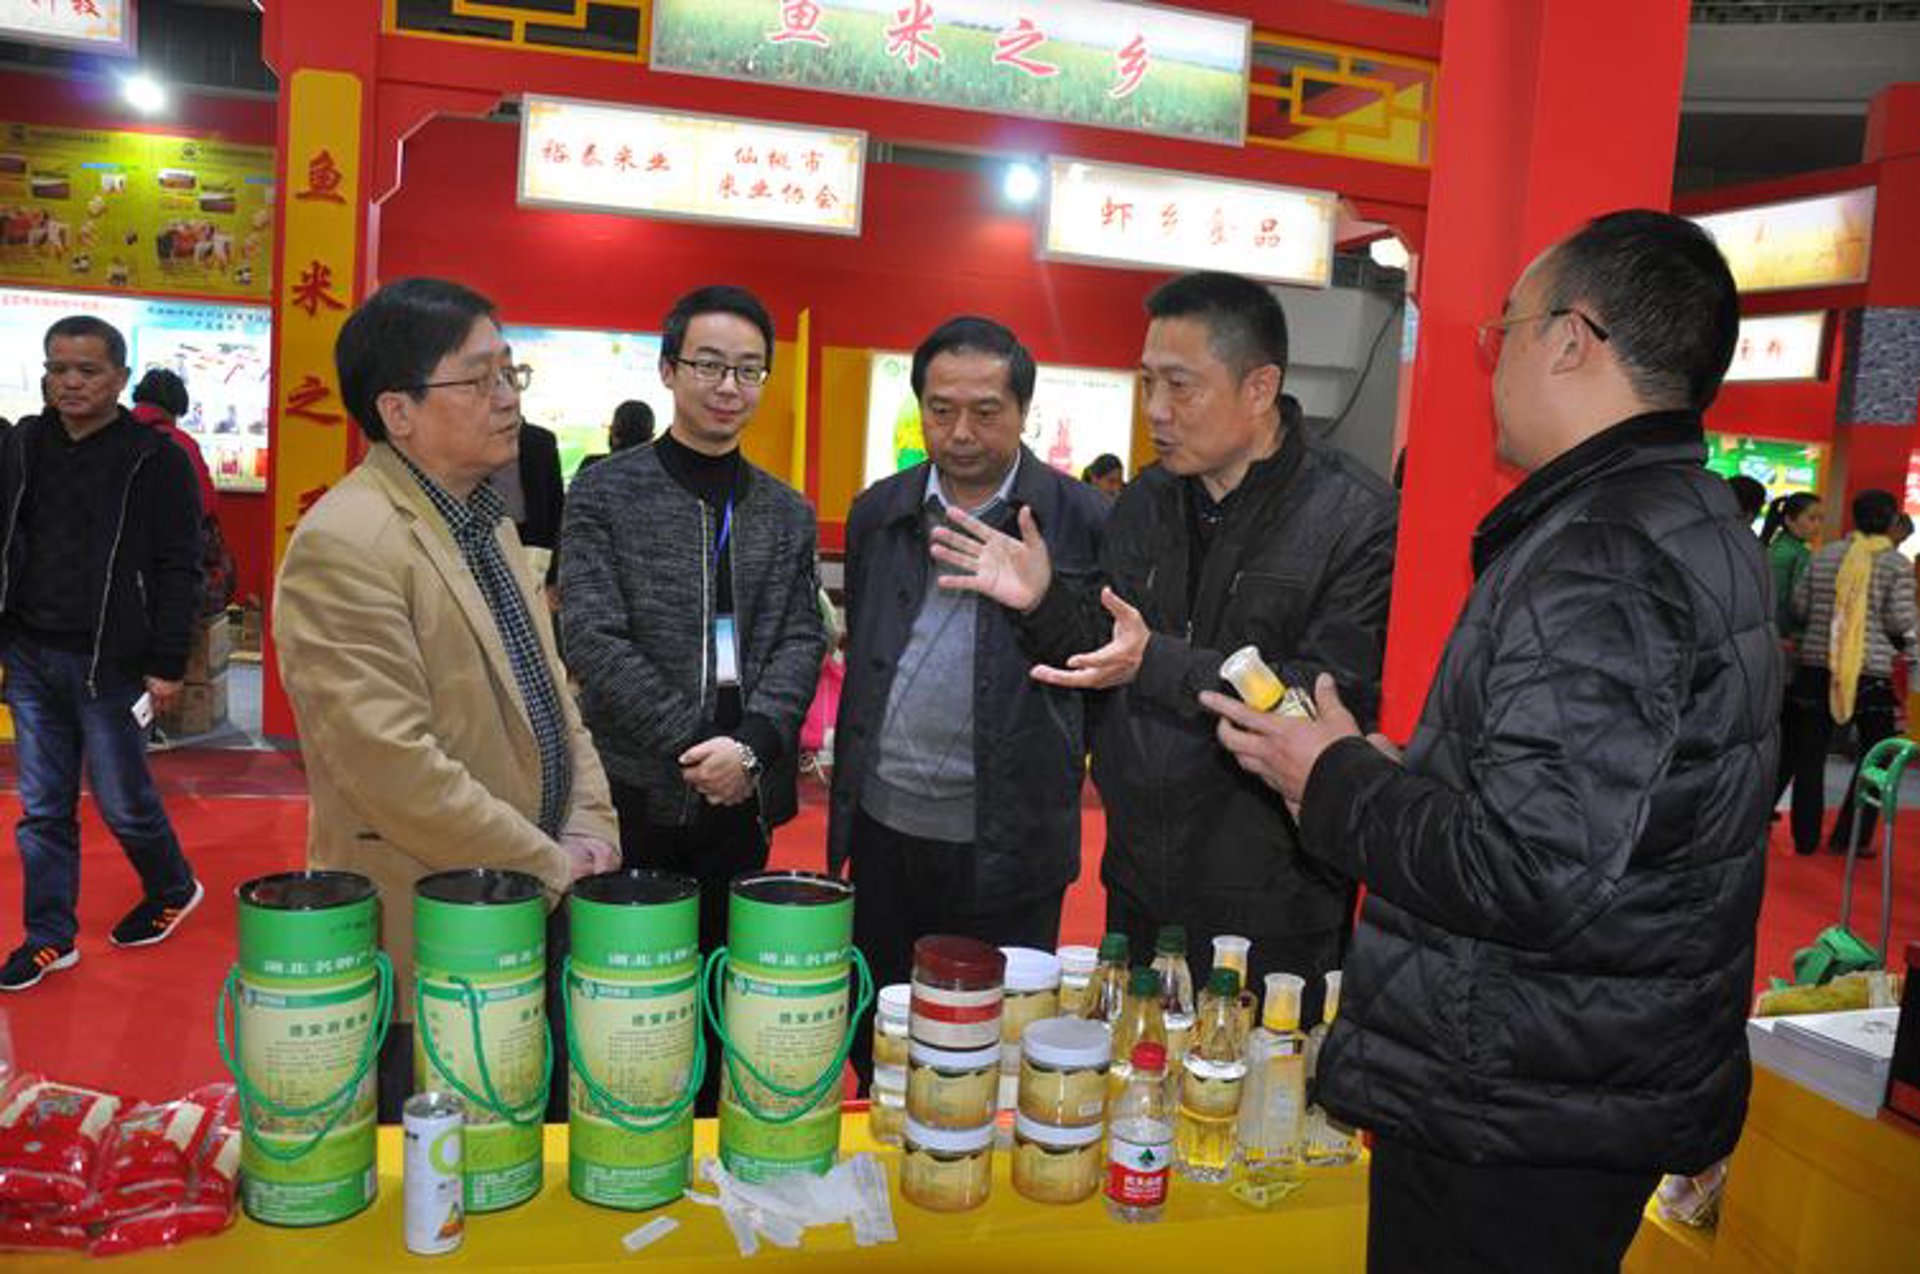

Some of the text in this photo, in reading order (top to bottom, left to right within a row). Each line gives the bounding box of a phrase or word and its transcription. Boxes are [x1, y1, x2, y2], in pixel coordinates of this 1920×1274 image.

[769, 0, 1153, 98] 鱼米之乡
[734, 146, 825, 173] 仙桃市
[718, 173, 839, 210] 米业协会
